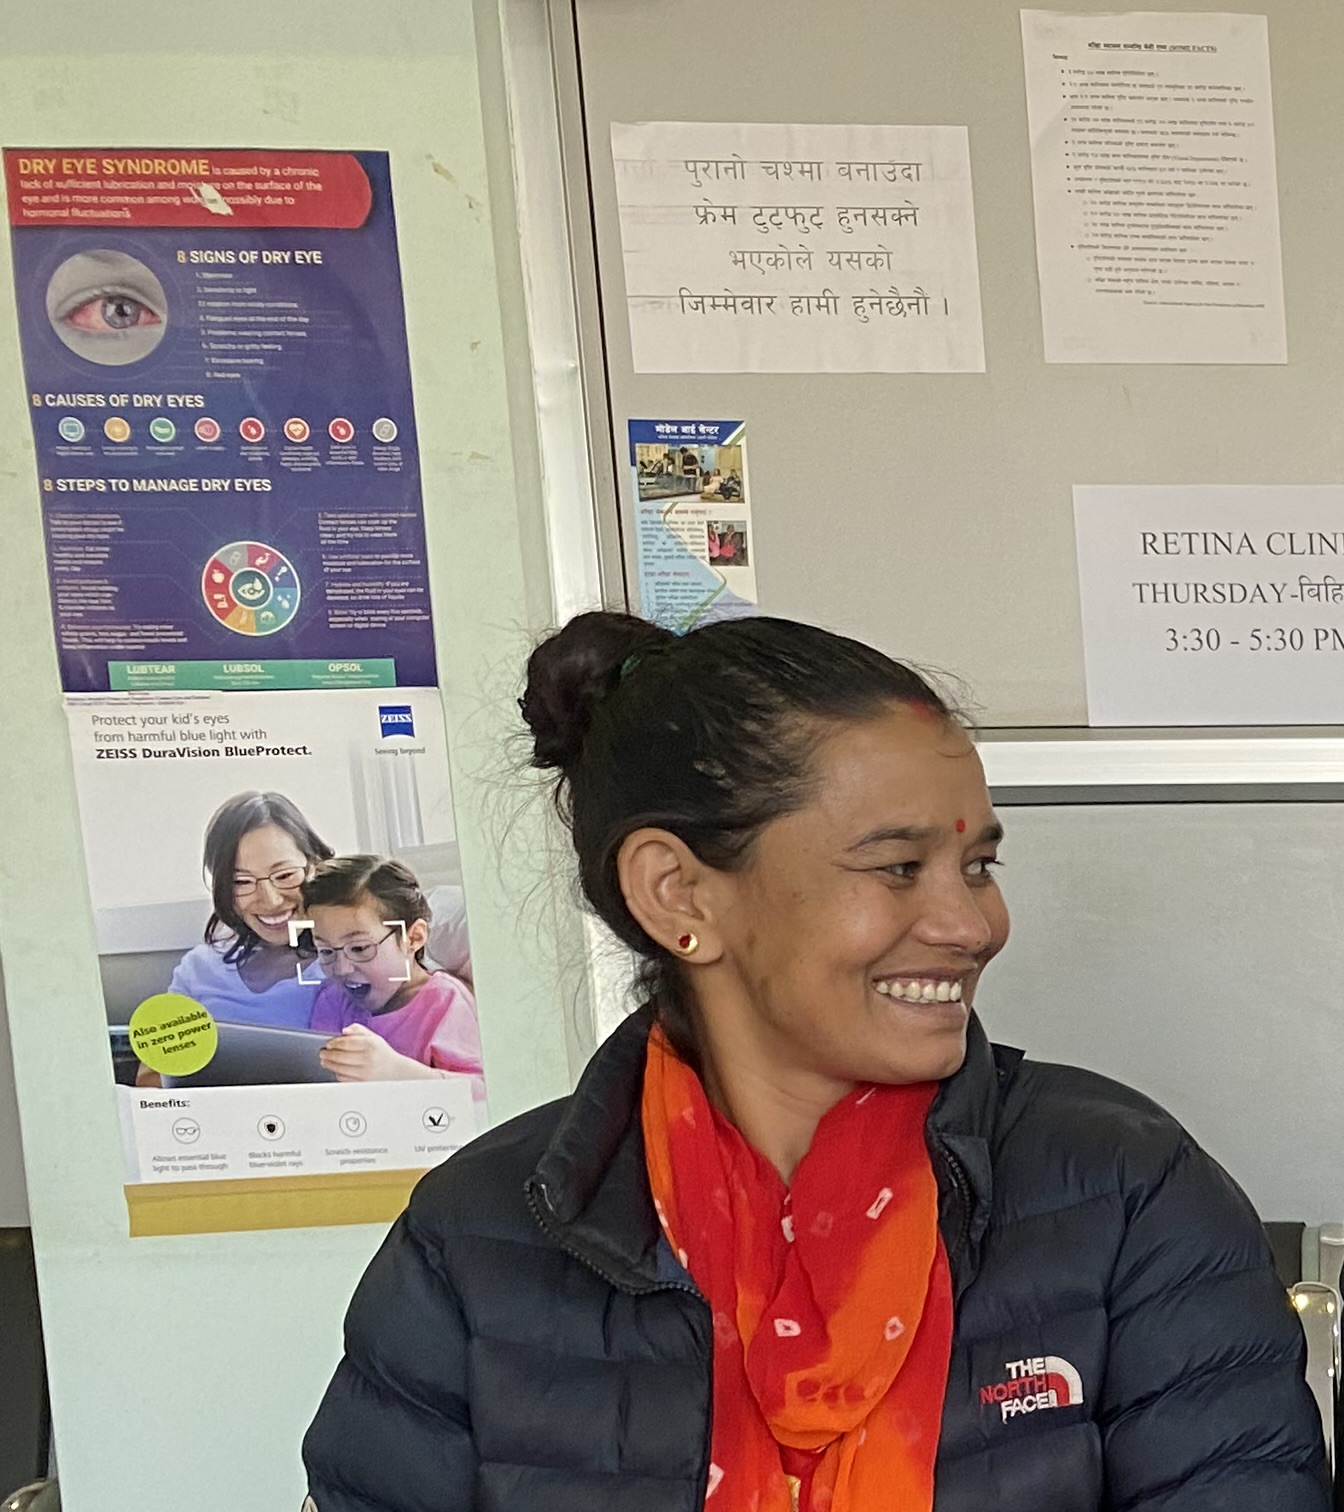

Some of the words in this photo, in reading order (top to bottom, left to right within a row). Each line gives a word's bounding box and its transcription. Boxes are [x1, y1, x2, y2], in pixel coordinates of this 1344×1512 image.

[19, 158, 55, 175] DRY
[62, 158, 97, 175] EYE
[102, 159, 210, 176] SYNDROME
[684, 153, 747, 187] पुरानो
[760, 160, 823, 181] चश्मा
[176, 251, 186, 264] 8
[190, 251, 235, 264] SIGNS
[239, 251, 258, 264] OF
[262, 252, 291, 264] DRY
[295, 252, 322, 264] EYE
[729, 243, 814, 275] भएकोले
[826, 243, 893, 271] यसको
[32, 394, 42, 407] 8
[45, 394, 105, 407] CAUSES
[109, 394, 129, 407] OF
[132, 395, 163, 407] DRY
[167, 395, 204, 408] EYES
[43, 479, 53, 492] 8
[57, 479, 106, 492] STEPS
[109, 479, 129, 492] TO
[133, 479, 199, 492] MANAGE
[202, 479, 232, 492] DRY
[235, 479, 272, 492] EYES
[1140, 531, 1257, 556] RETINA
[1165, 628, 1221, 651] 3:30
[1249, 628, 1304, 651] 5:30
[92, 714, 136, 726] Protect
[140, 716, 167, 728] your
[171, 713, 199, 725] kid's
[203, 715, 230, 727] eyes
[381, 713, 413, 723] ZEISS
[94, 732, 124, 743] from
[128, 731, 176, 742] harmful
[179, 730, 206, 741] blue
[210, 729, 236, 743] light
[240, 729, 267, 740] with
[96, 748, 137, 759] ZEISS
[142, 747, 220, 759] DuraVision
[133, 1026, 157, 1039] Also
[159, 1010, 208, 1031] available
[137, 1040, 149, 1050] in
[151, 1033, 175, 1046] zero
[177, 1021, 211, 1040] power
[162, 1040, 197, 1055] lenses
[140, 1099, 191, 1109] Benefits:
[1005, 1357, 1045, 1379] THE
[979, 1373, 1047, 1405] NORTH
[1001, 1392, 1049, 1424] FACE
